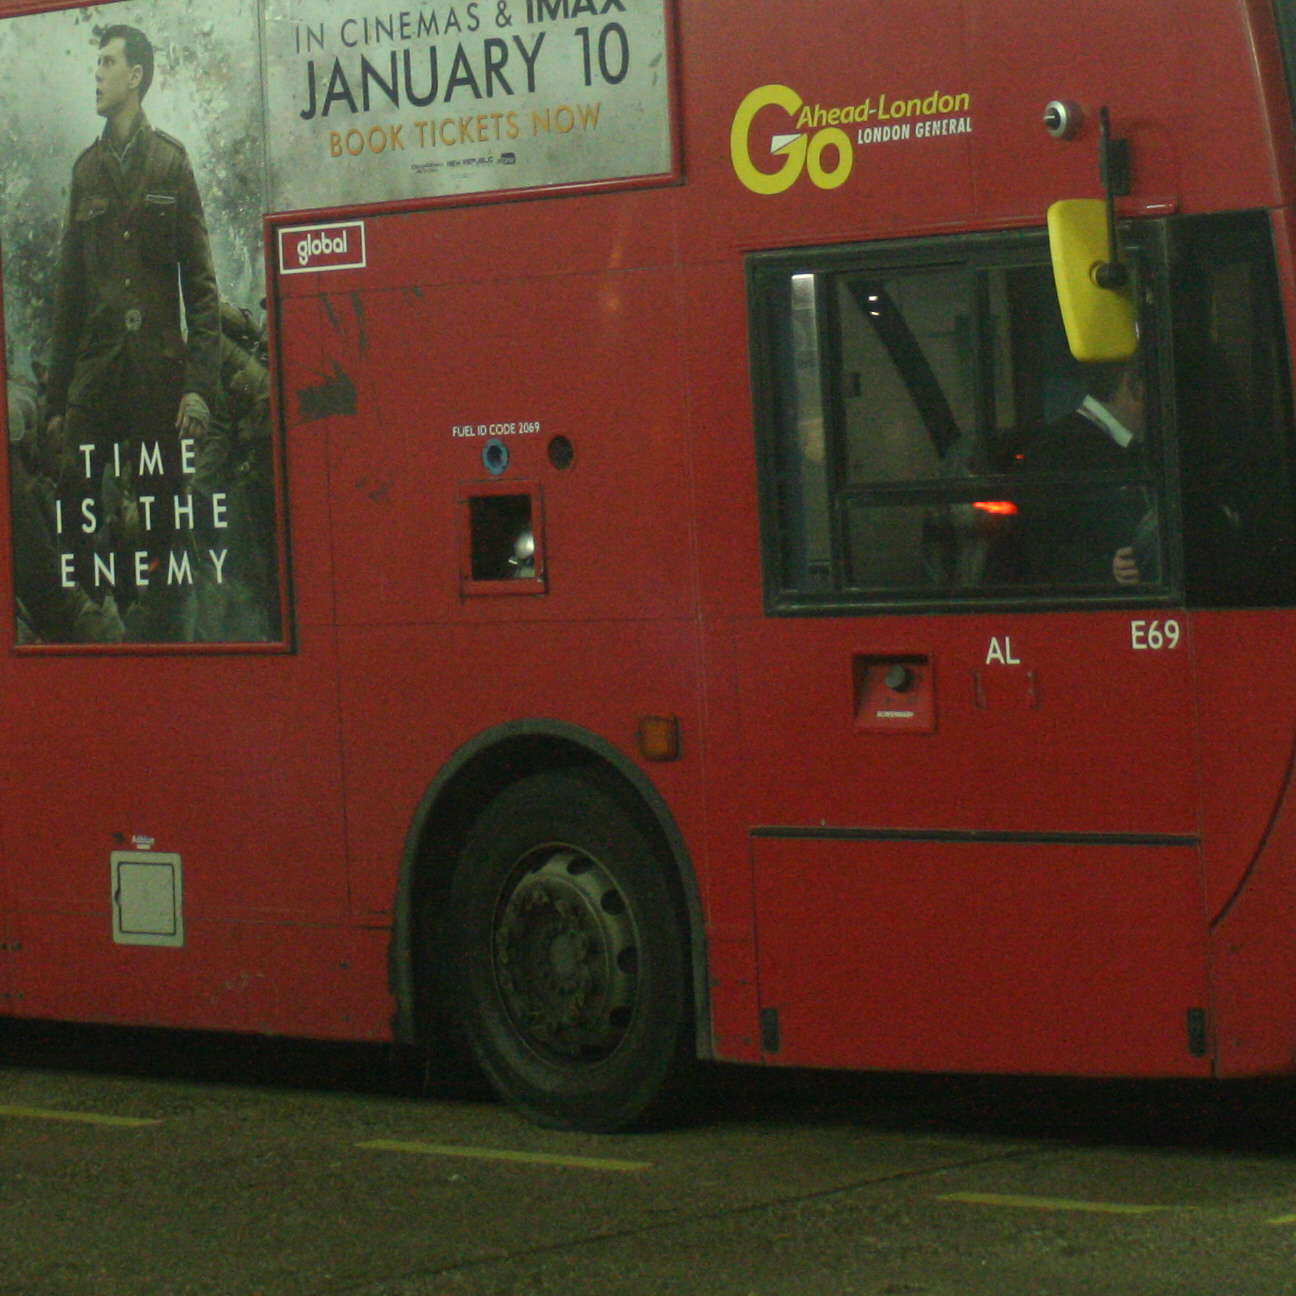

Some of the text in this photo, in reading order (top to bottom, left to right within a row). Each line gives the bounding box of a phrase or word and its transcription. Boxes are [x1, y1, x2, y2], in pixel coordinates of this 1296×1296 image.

[295, 22, 324, 54] IN
[340, 2, 480, 48] CINEMAS
[495, 0, 513, 28] &
[299, 22, 630, 120] JANUARY 10
[329, 102, 602, 157] BOOK TICKETS NOW
[730, 84, 970, 195] Go Ahead-London
[857, 117, 972, 145] LONDON GENERAL
[296, 229, 348, 266] global
[452, 421, 540, 437] FUEL ID CODE 2069
[79, 438, 196, 478] TIME
[56, 493, 228, 534] IS THE
[61, 548, 228, 588] ENEMY
[985, 636, 1021, 665] AL
[1130, 619, 1180, 650] E69
